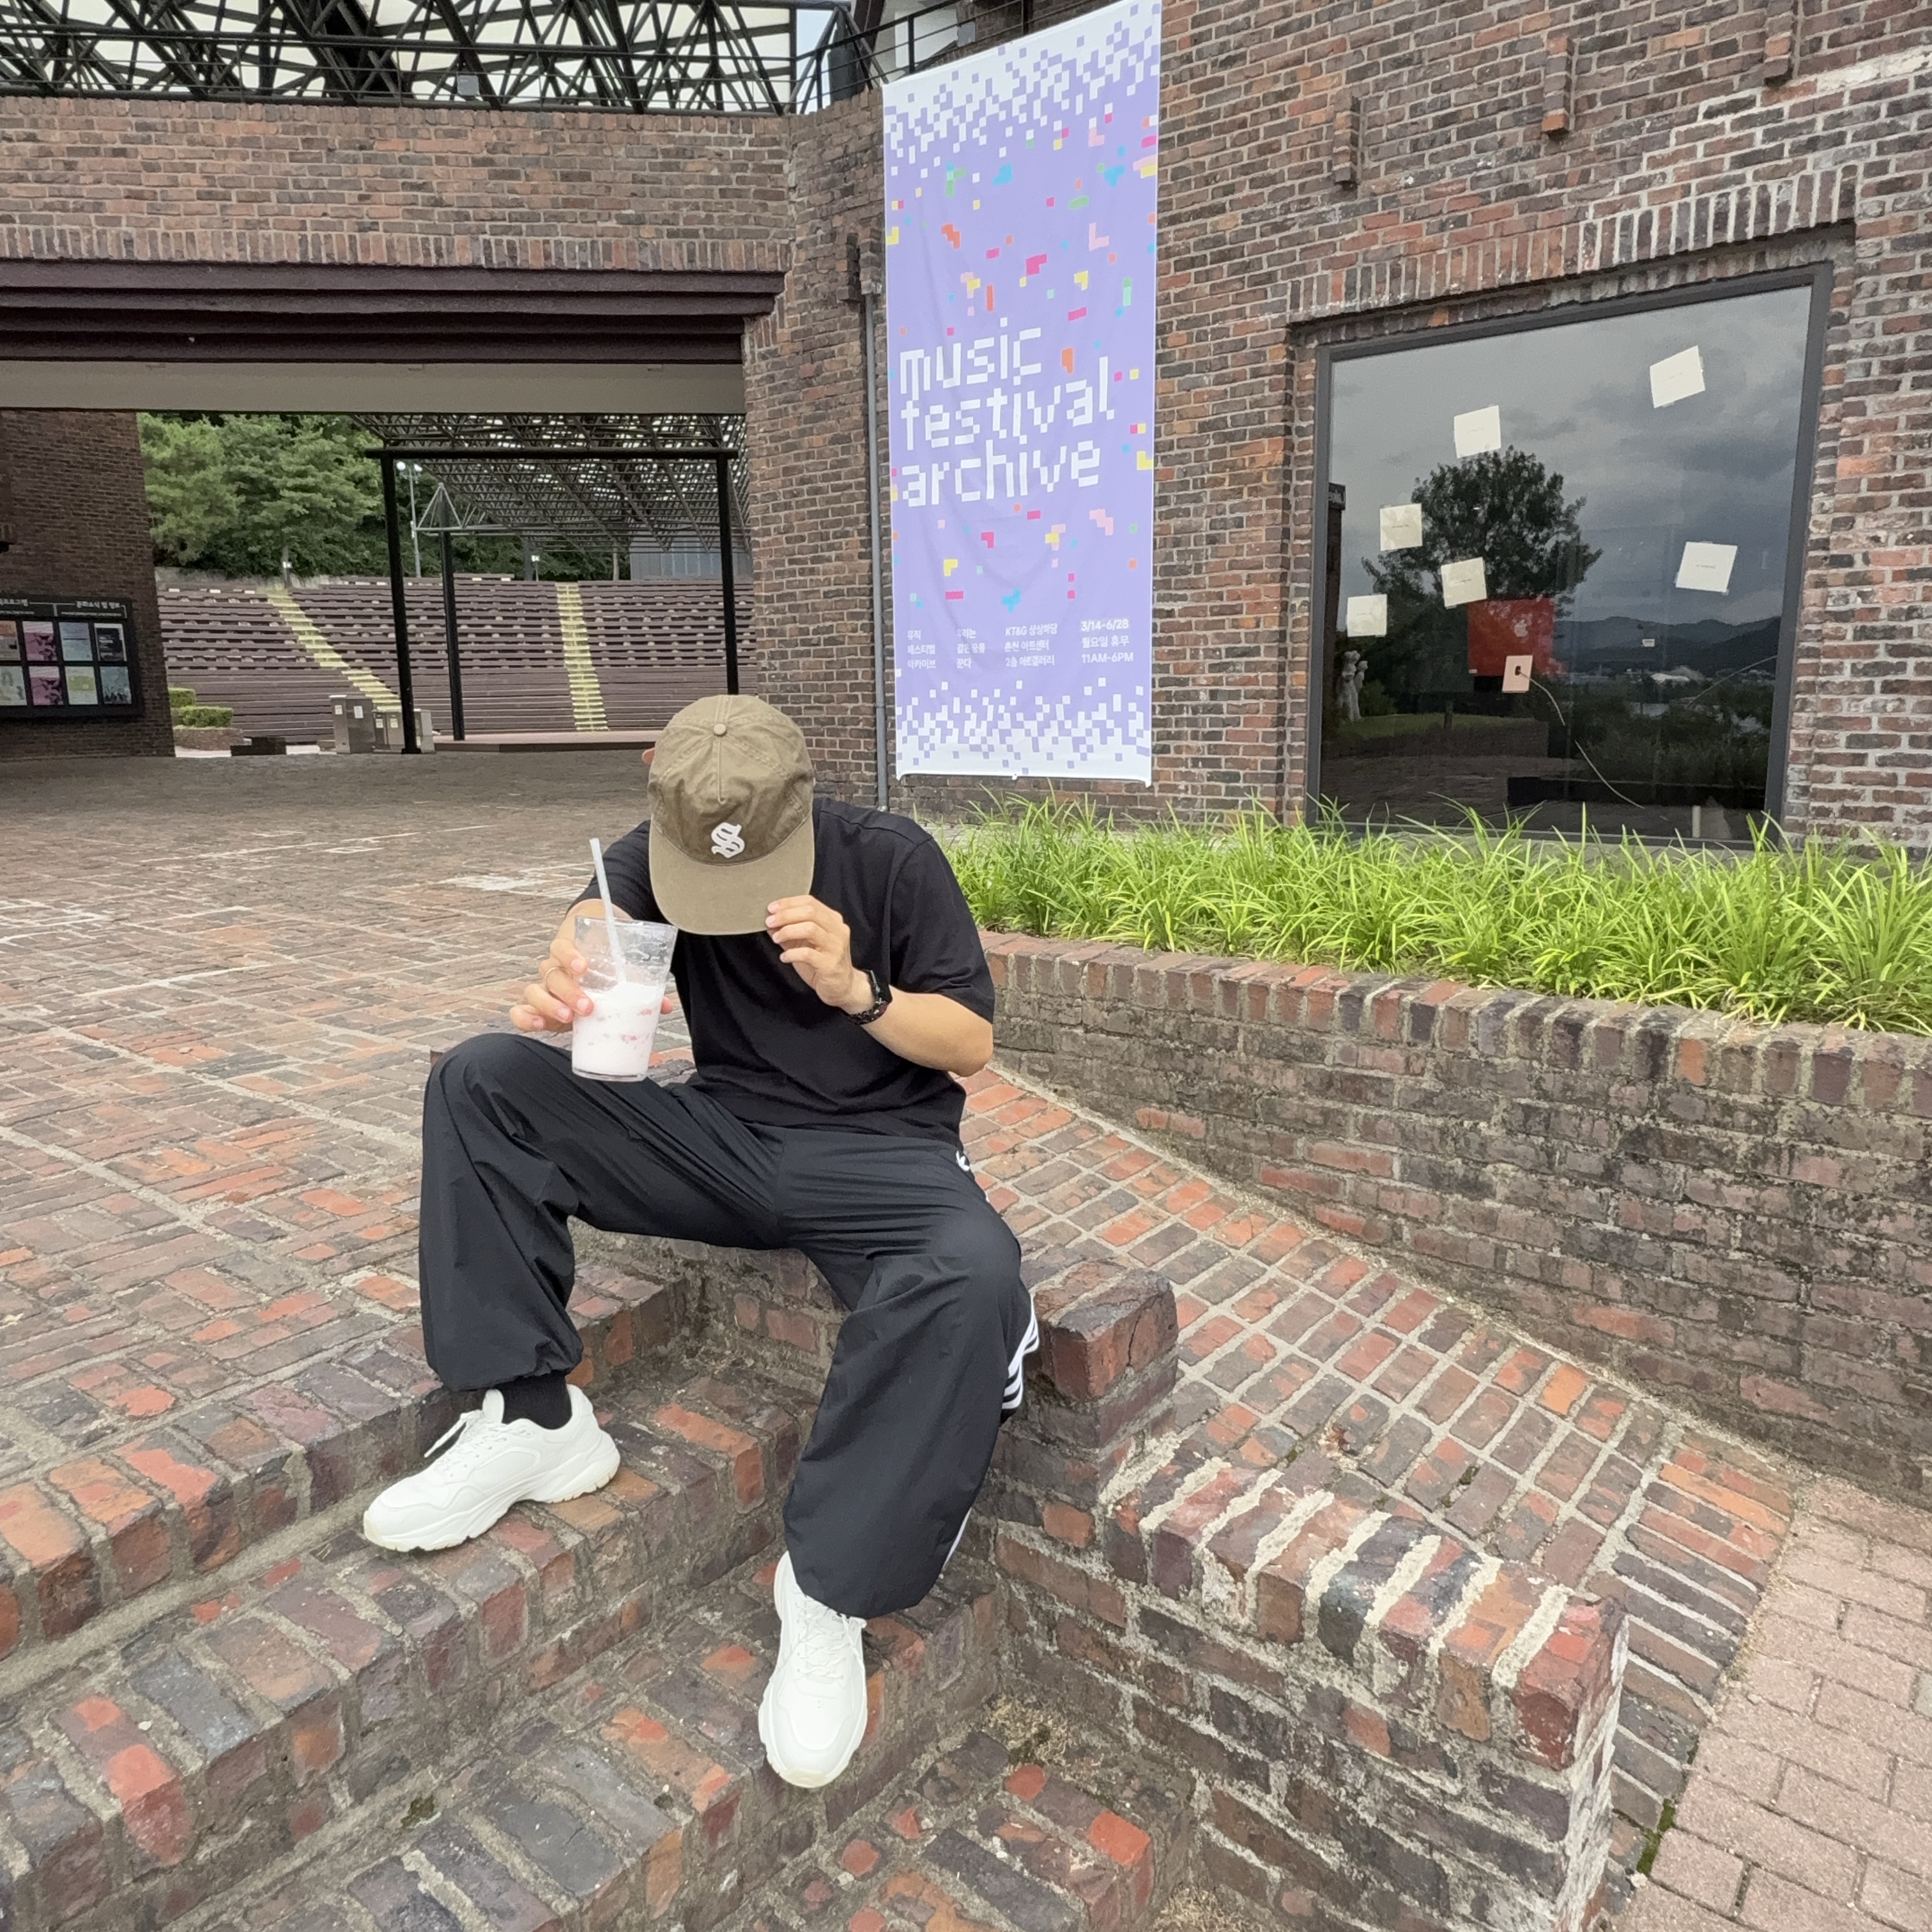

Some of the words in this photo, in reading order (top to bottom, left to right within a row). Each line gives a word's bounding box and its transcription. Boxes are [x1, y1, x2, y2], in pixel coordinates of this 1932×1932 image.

[900, 317, 1041, 401] music
[900, 356, 1115, 451] festival
[901, 439, 1100, 507] archive
[1005, 625, 1027, 636] KT&G
[1029, 622, 1058, 636] 상상마당
[1081, 618, 1129, 632] 3/14-6/28
[907, 630, 921, 640] 뮤직
[957, 628, 977, 639] 우리는
[1021, 639, 1049, 651] 아트센터
[1082, 635, 1108, 648] 월요일
[1110, 635, 1130, 647] 휴무
[907, 643, 935, 654] 페스티벌
[957, 657, 971, 668] 꾼다
[1005, 656, 1018, 668] 2층
[1019, 654, 1055, 666] 아트갤러리
[1081, 652, 1134, 663] 11AM-6PM
[907, 659, 937, 669] 아카이브
